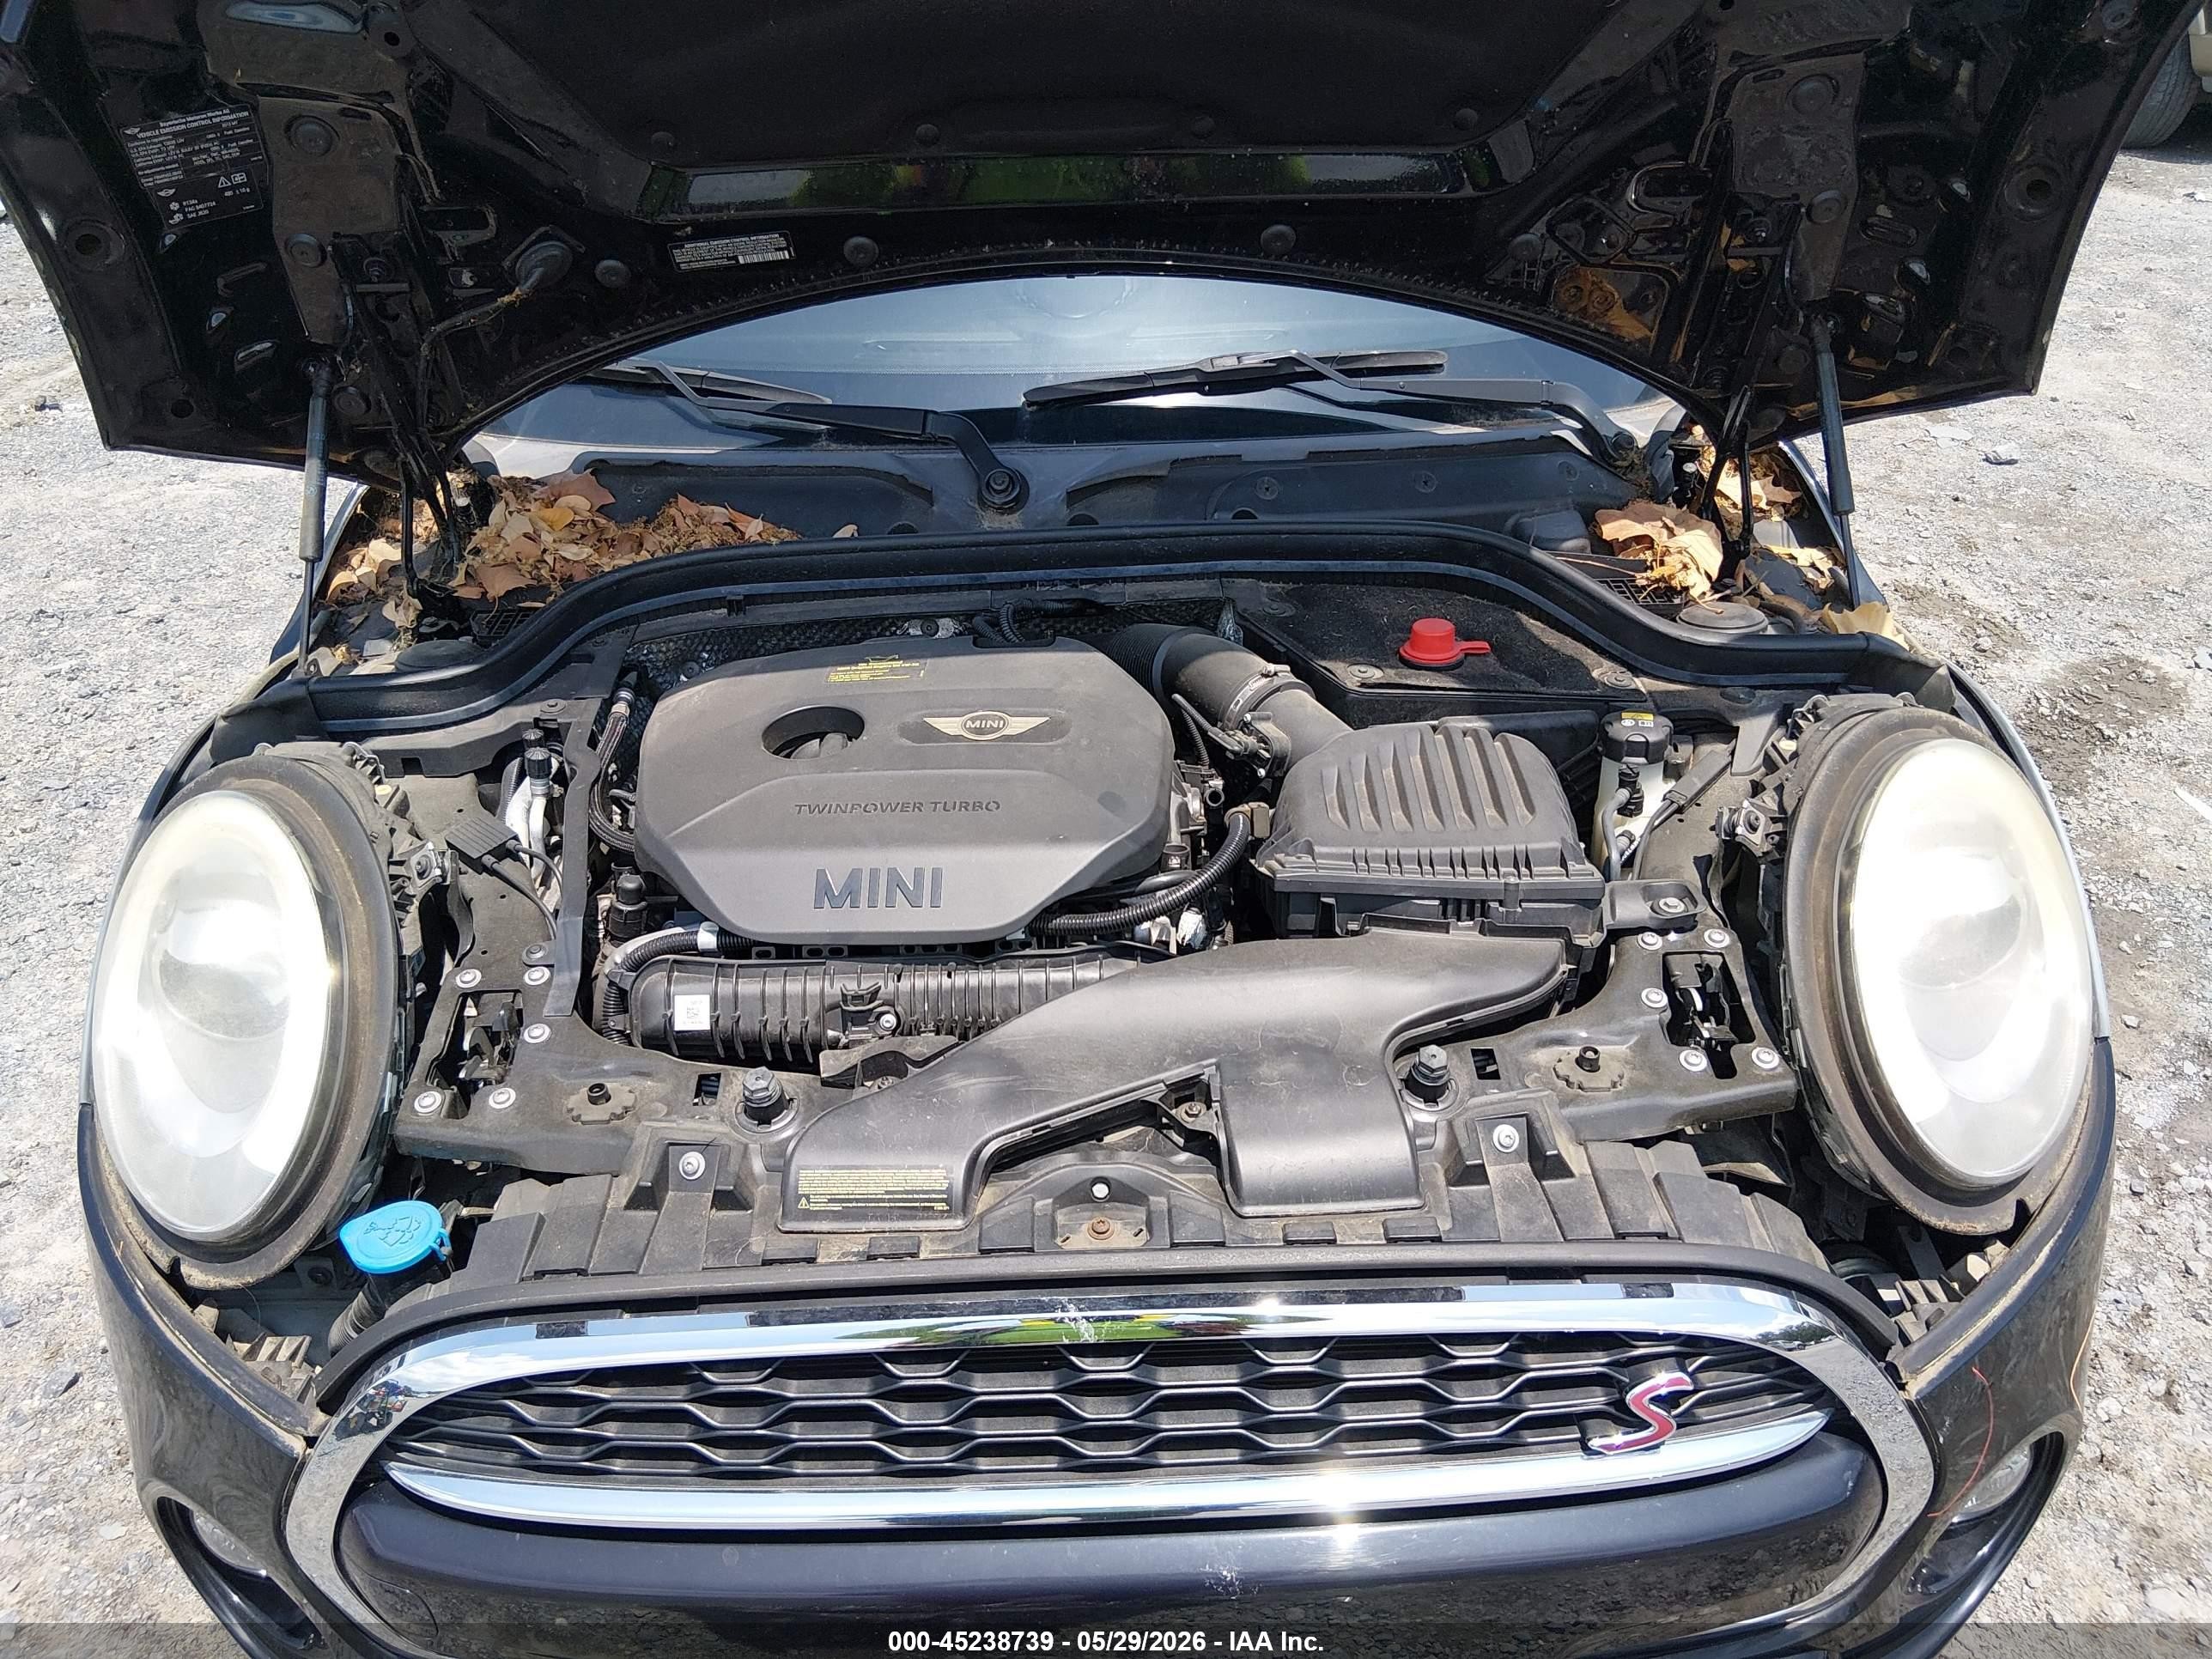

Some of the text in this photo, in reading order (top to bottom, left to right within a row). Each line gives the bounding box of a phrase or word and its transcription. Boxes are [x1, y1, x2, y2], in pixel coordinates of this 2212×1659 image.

[186, 118, 212, 129] CONTROL
[965, 720, 1005, 729] MINI
[794, 799, 1000, 815] TWINPOWER TURBO
[813, 866, 944, 908] MINI
[1587, 1371, 1694, 1455] S
